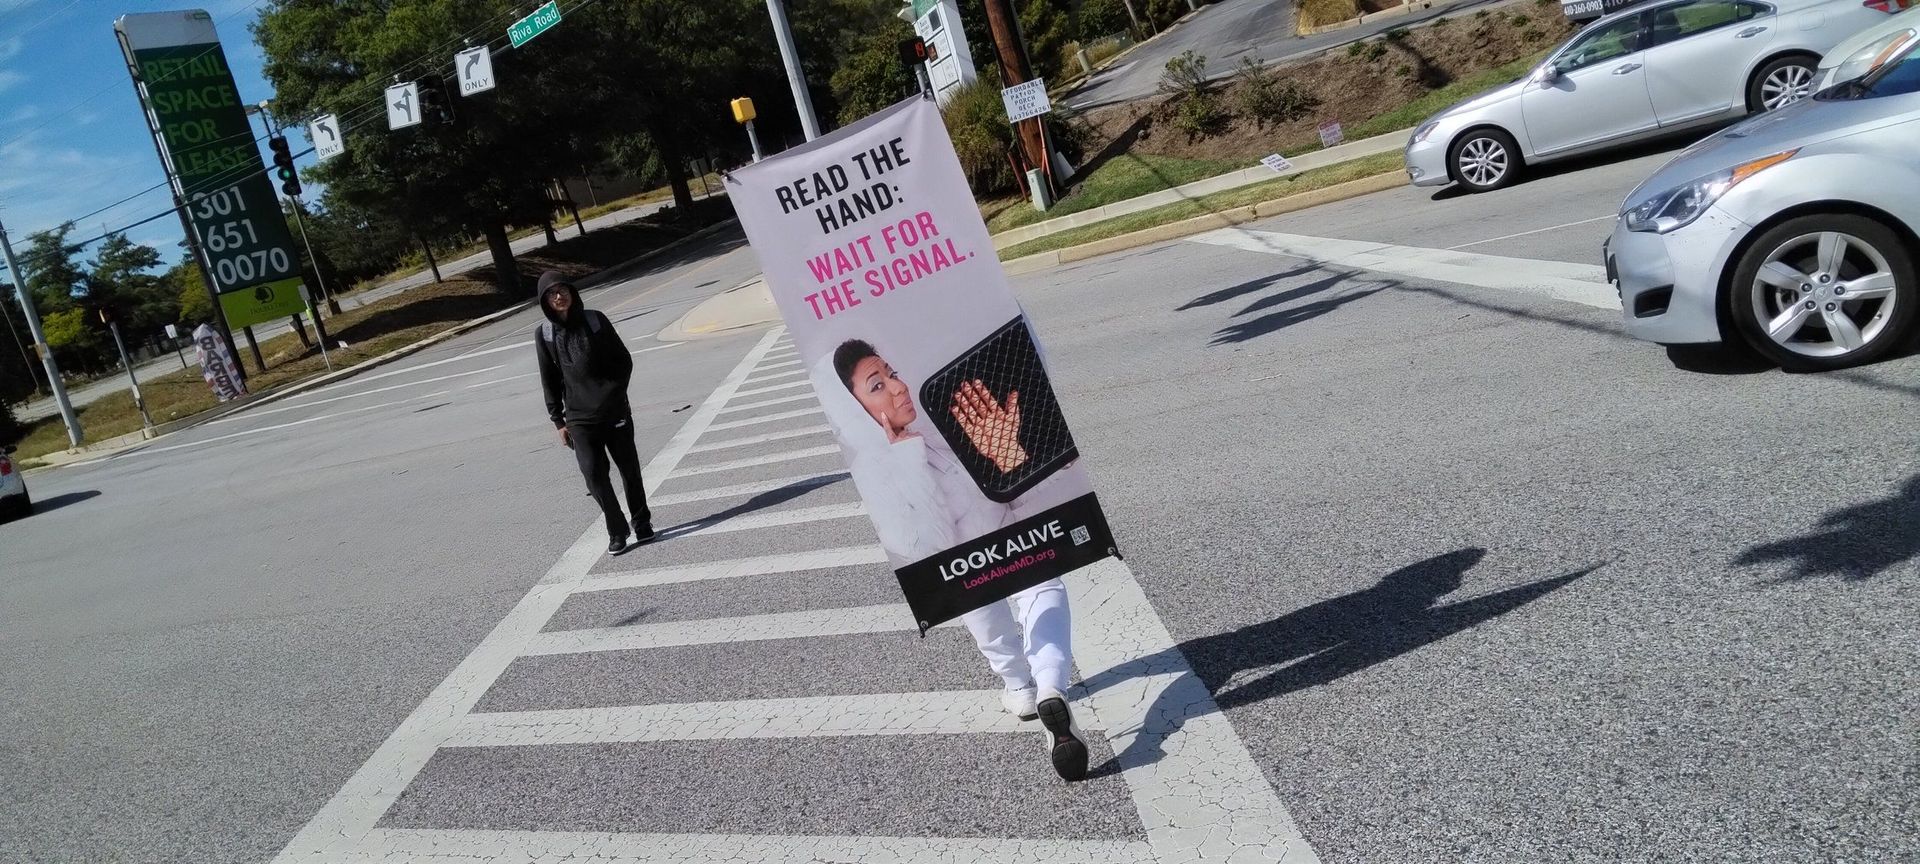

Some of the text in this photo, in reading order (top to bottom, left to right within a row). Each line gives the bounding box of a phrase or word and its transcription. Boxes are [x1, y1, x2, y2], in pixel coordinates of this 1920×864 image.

[511, 7, 557, 43] Riva Road
[143, 55, 228, 81] RETAIL
[465, 77, 488, 91] ONLY
[154, 84, 236, 115] SPACE
[1014, 95, 1036, 106] PORCH
[164, 118, 220, 146] FOR
[176, 146, 252, 177] LEASE
[320, 143, 338, 157] ONLY
[775, 136, 911, 215] READ THE
[192, 186, 247, 219] 301
[815, 182, 904, 235] HAND:
[207, 218, 258, 252] 651
[806, 211, 940, 284] WAIT FOR
[216, 247, 289, 285] 0070
[804, 238, 975, 321] THE SIGNAL.
[939, 519, 1065, 582] LOOK ALIVE
[963, 549, 1056, 590] LookAliveMD.org
